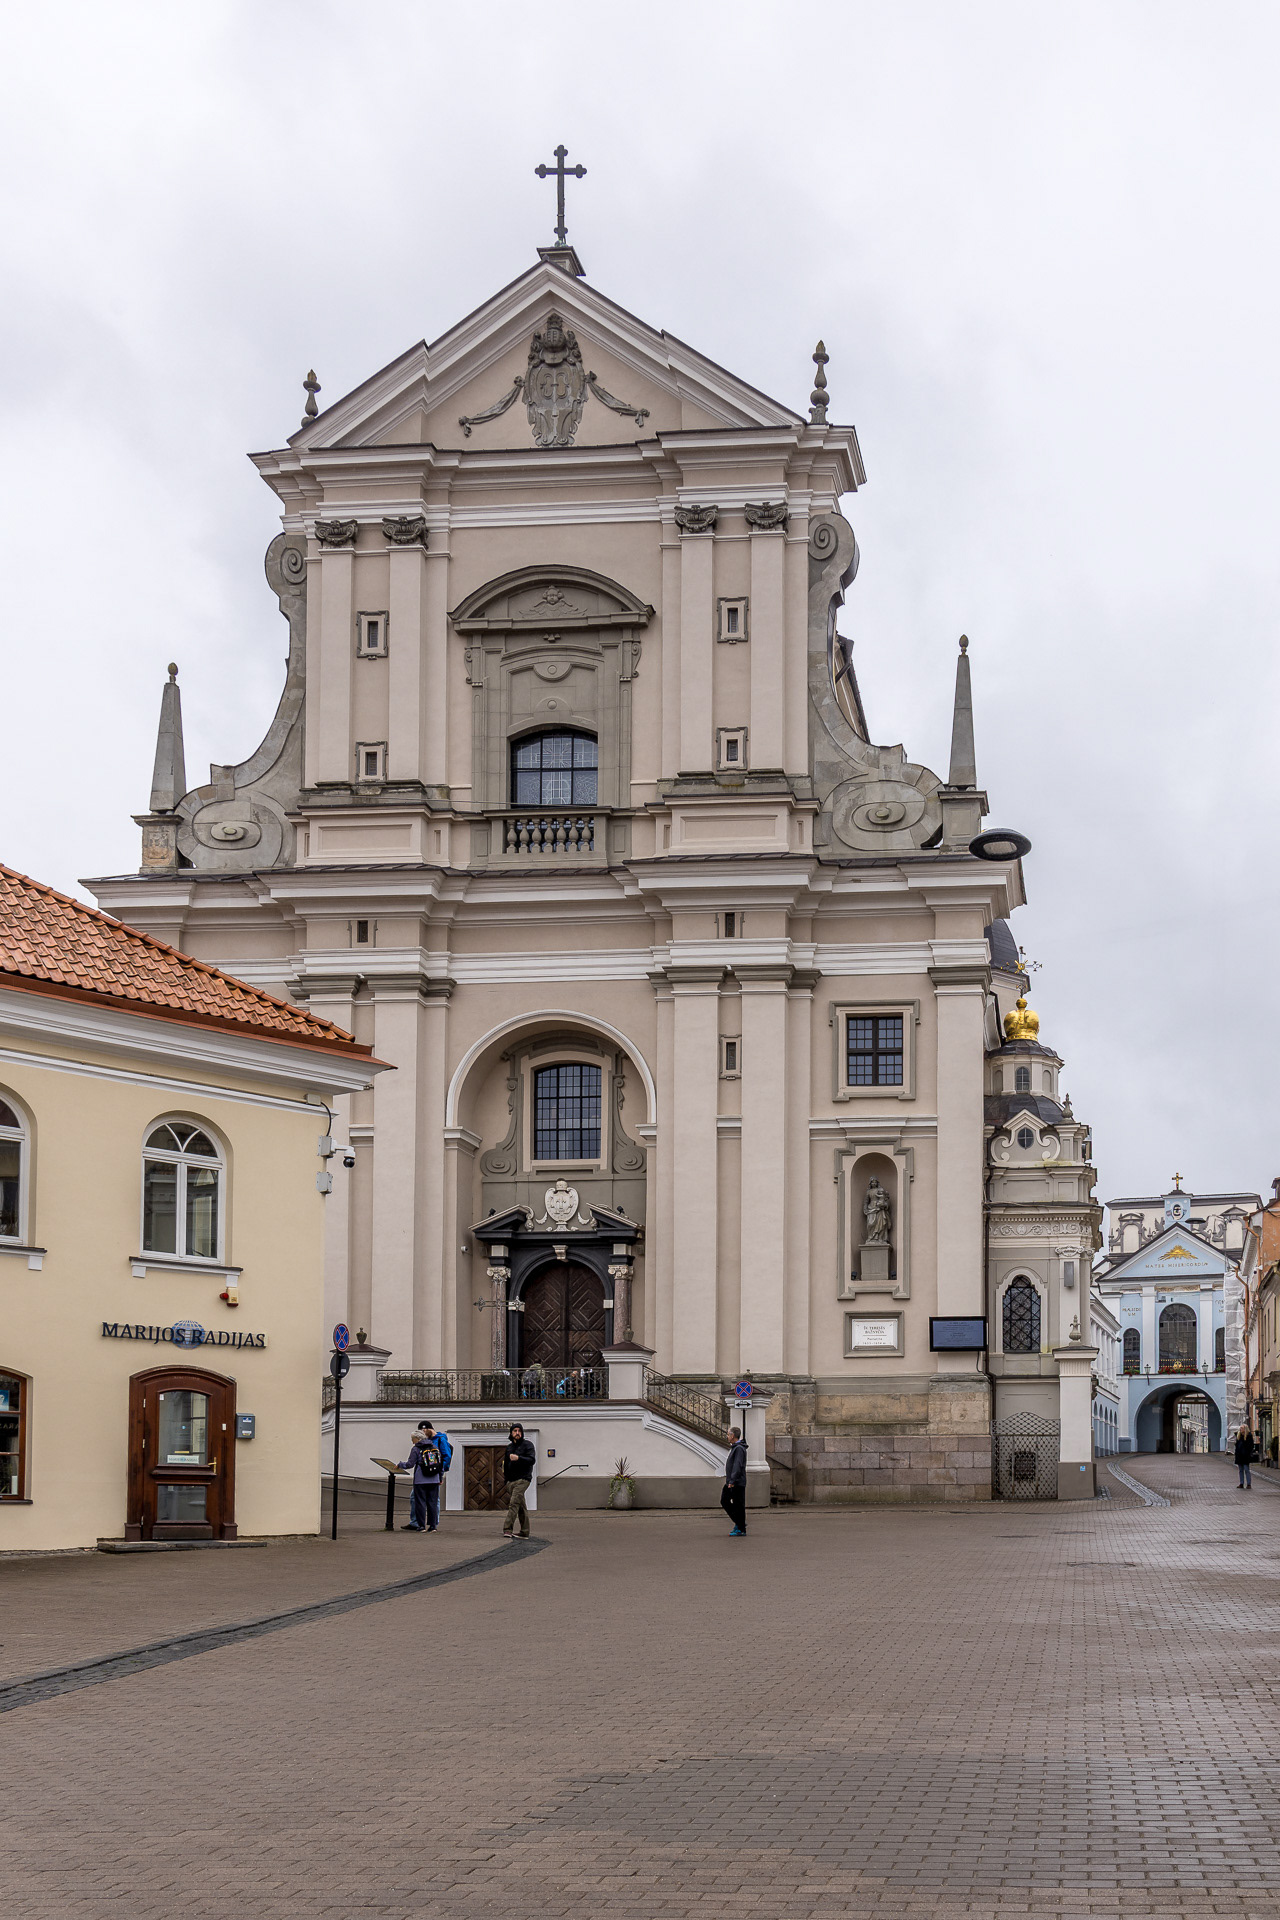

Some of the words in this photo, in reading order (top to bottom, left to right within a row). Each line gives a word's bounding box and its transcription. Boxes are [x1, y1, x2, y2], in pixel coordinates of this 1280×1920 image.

[102, 1322, 186, 1345] MARIJOS
[191, 1329, 266, 1350] RADIJAS
[471, 1422, 514, 1430] PEREGRIN
